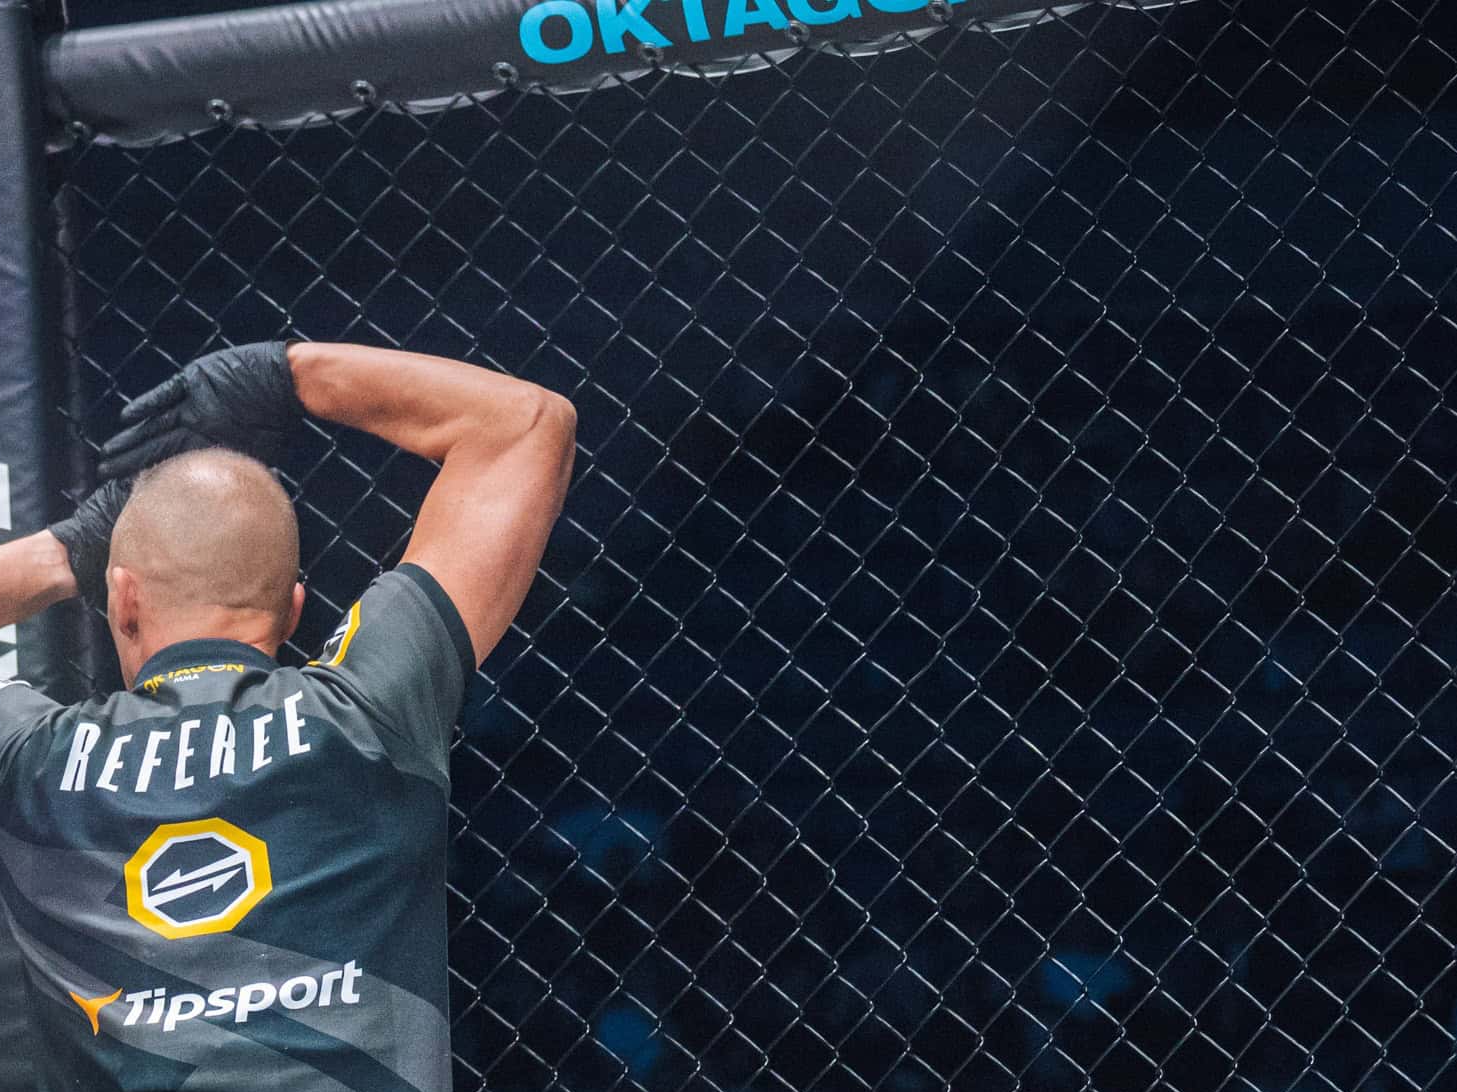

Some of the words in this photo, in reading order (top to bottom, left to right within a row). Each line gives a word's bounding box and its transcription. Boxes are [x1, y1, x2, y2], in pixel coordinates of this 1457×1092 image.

[519, 0, 966, 65] OKTA
[173, 673, 200, 684] MMA
[59, 689, 311, 793] REFEREE
[123, 959, 363, 1032] Tipsport
